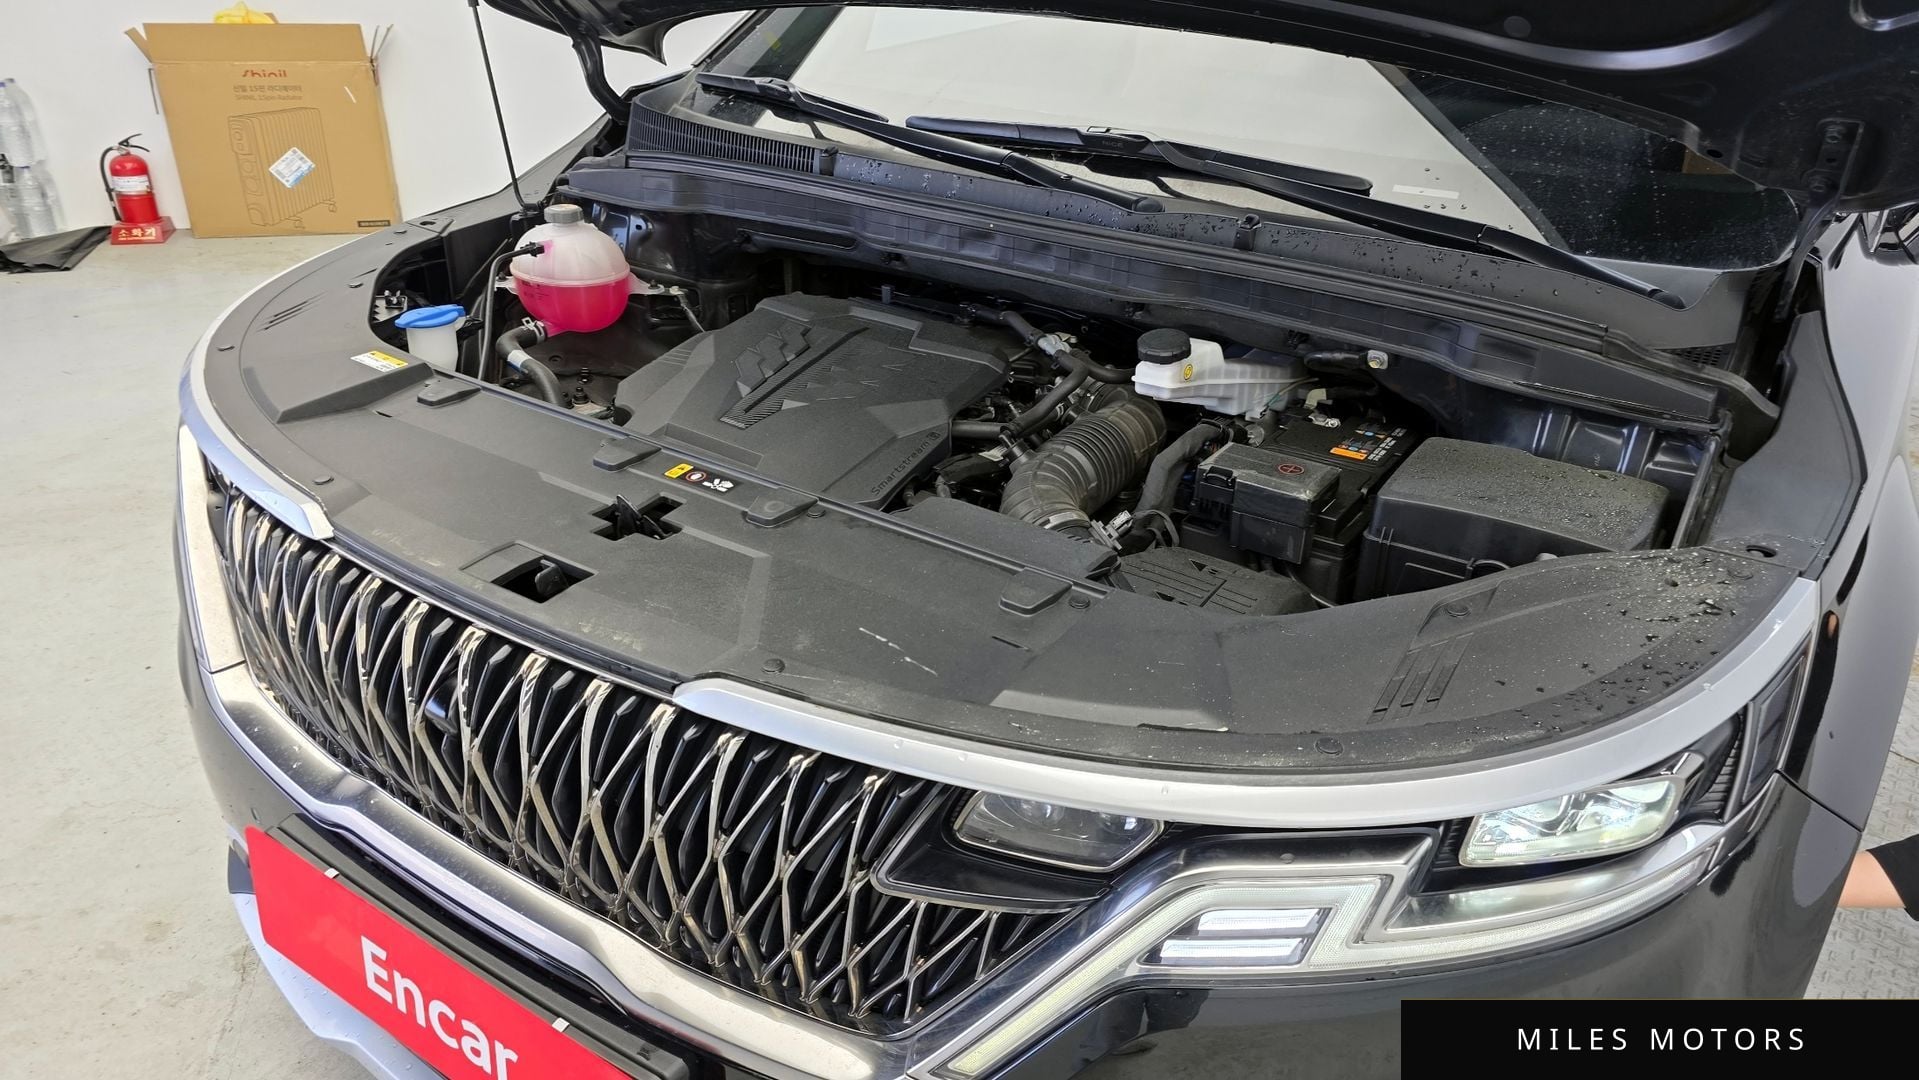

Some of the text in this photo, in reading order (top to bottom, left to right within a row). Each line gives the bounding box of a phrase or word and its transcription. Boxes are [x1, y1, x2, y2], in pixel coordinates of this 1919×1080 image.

[242, 69, 287, 78] Shinil
[118, 226, 156, 238] 소화기
[871, 440, 931, 496] Smartstream
[361, 935, 519, 1080] Encar
